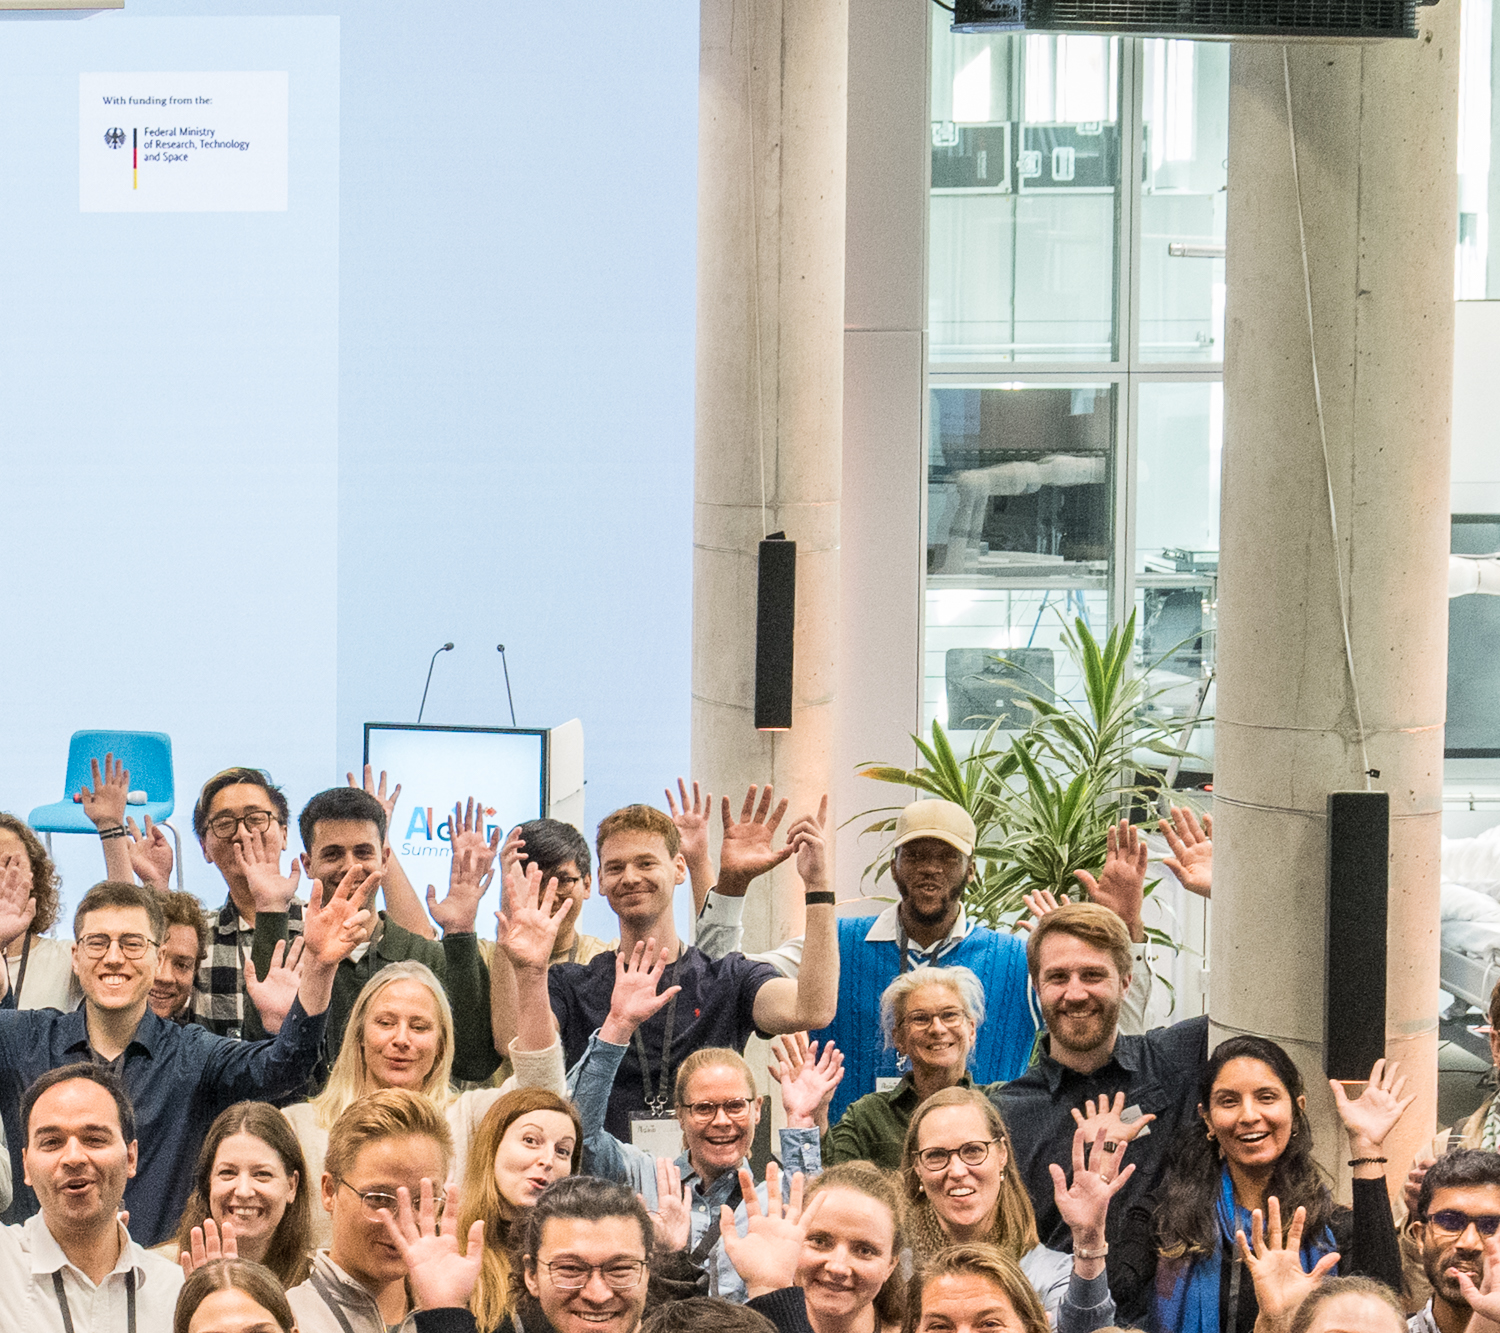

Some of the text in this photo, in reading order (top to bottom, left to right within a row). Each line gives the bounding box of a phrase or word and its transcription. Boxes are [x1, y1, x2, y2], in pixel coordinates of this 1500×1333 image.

[103, 96, 213, 107] With funding from the:
[144, 127, 215, 138] Federal Ministry
[144, 140, 250, 151] of Research, Technology
[144, 152, 188, 163] and Space
